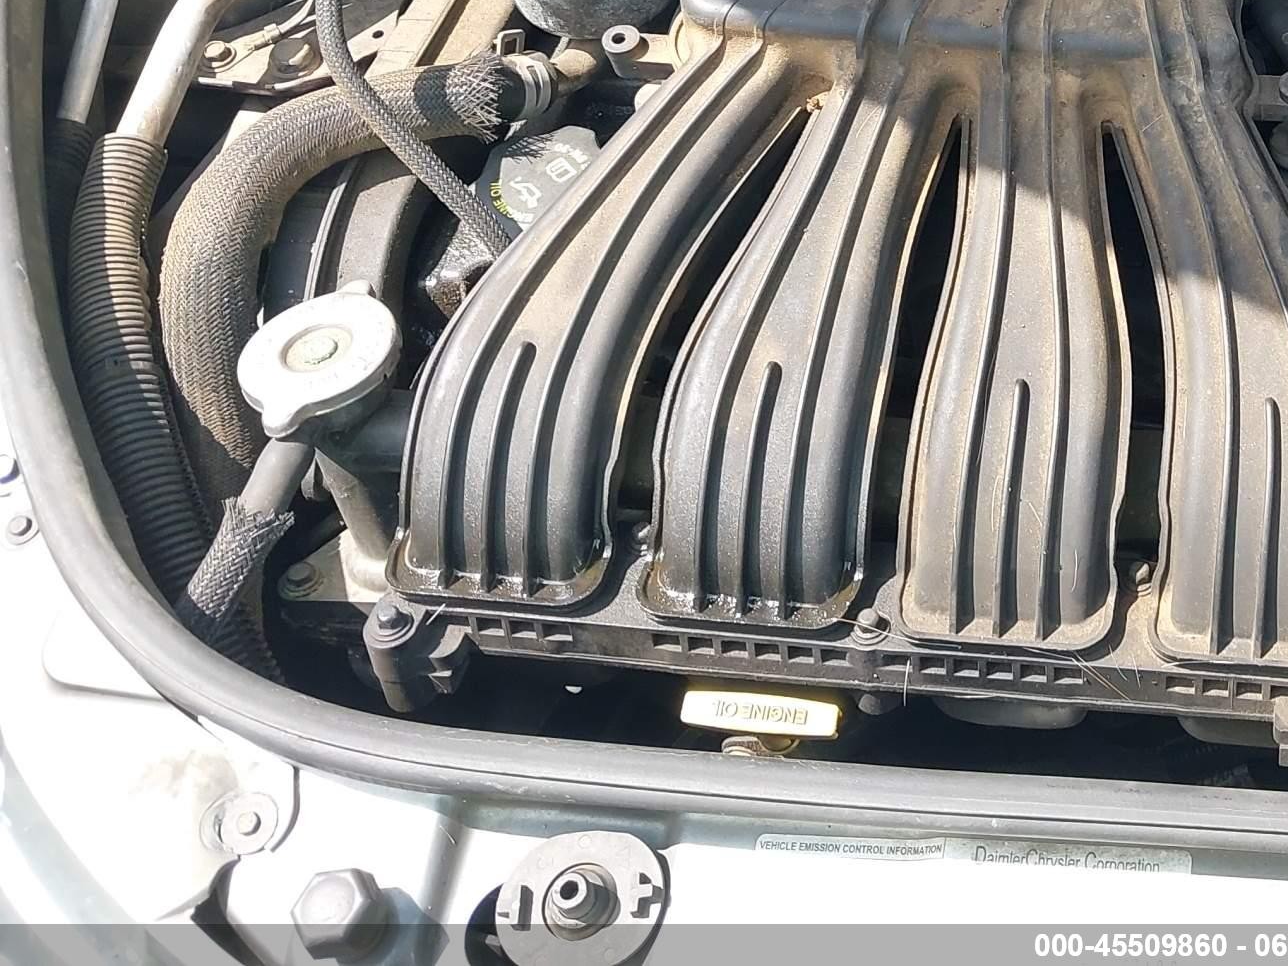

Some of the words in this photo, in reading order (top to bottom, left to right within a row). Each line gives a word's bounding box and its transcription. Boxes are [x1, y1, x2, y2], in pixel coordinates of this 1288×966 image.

[712, 700, 738, 718] OIL
[742, 704, 809, 726] ENGINE
[759, 841, 797, 851] VEHICLE
[799, 842, 841, 853] EMISSION
[843, 844, 884, 855] CONTROL
[886, 844, 942, 856] INFORMATION
